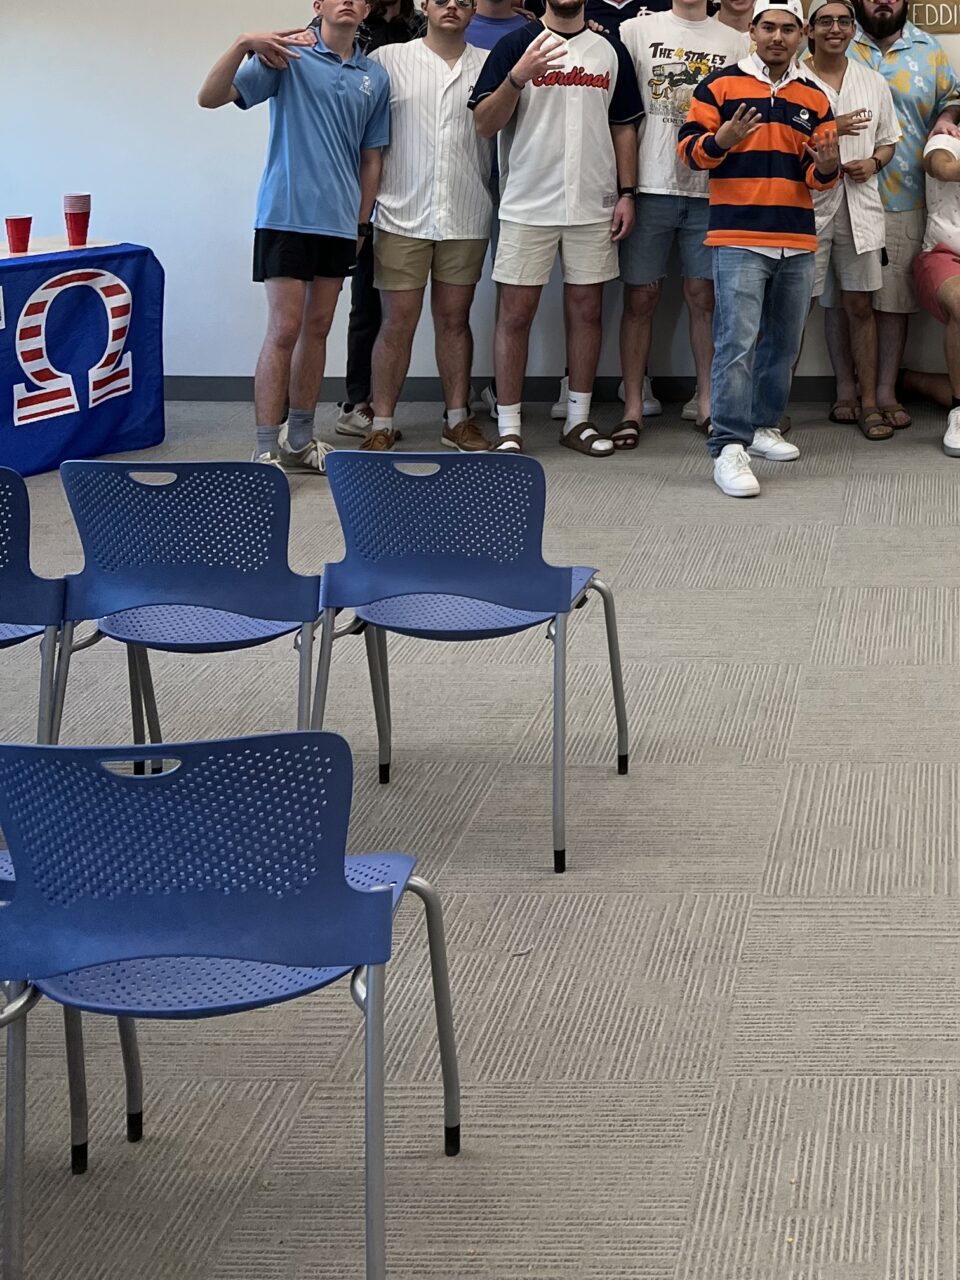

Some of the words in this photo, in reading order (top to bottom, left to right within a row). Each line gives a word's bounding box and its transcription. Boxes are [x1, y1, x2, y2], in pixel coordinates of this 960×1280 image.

[674, 47, 686, 60] 4
[532, 65, 610, 91] Cardinal
[0, 267, 132, 426] Ω
